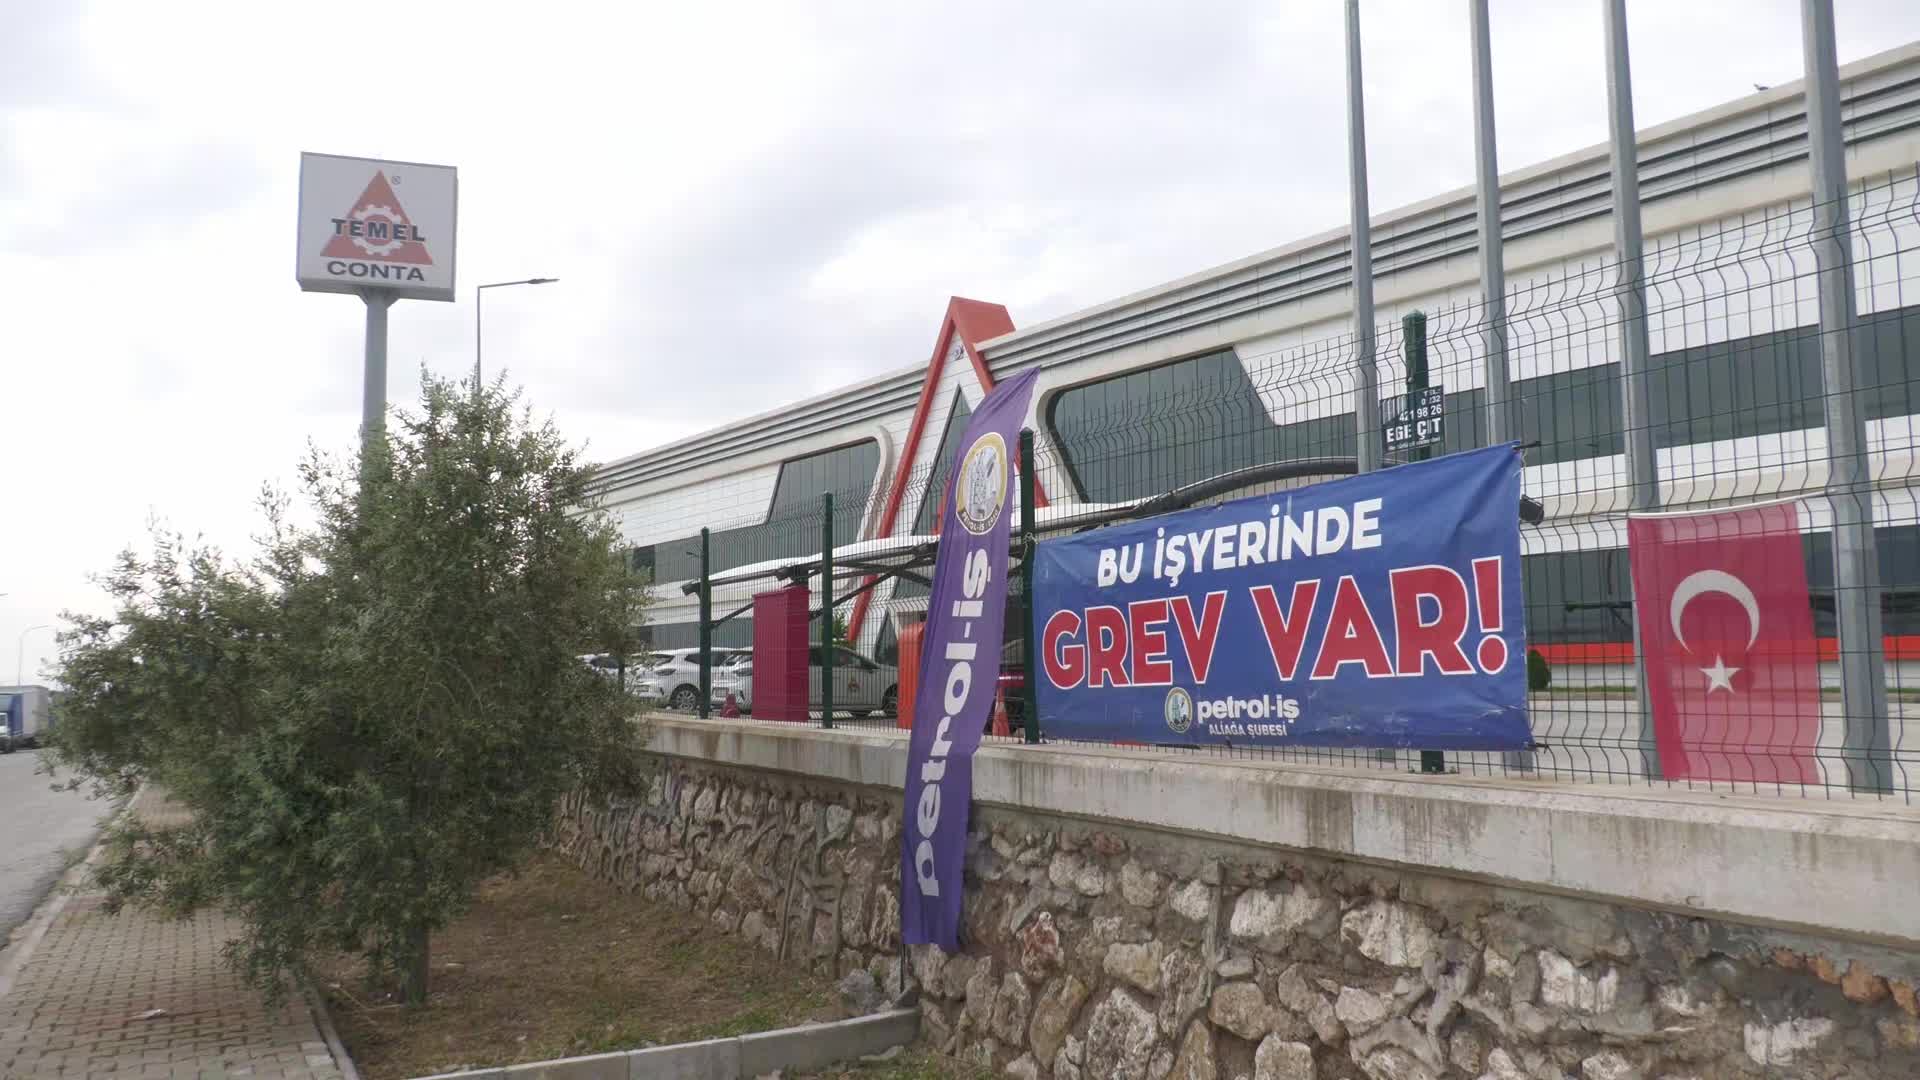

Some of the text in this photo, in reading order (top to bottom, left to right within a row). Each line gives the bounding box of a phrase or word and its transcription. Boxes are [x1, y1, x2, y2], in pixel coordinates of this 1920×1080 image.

[331, 218, 426, 242] TEMEL
[327, 261, 425, 282] CONTA
[1417, 407, 1428, 418] 98
[1430, 404, 1442, 415] 26
[1386, 424, 1412, 443] EGE
[1097, 497, 1383, 588] BU İŞYERİNDE
[1042, 555, 1509, 690] GREV VAR!
